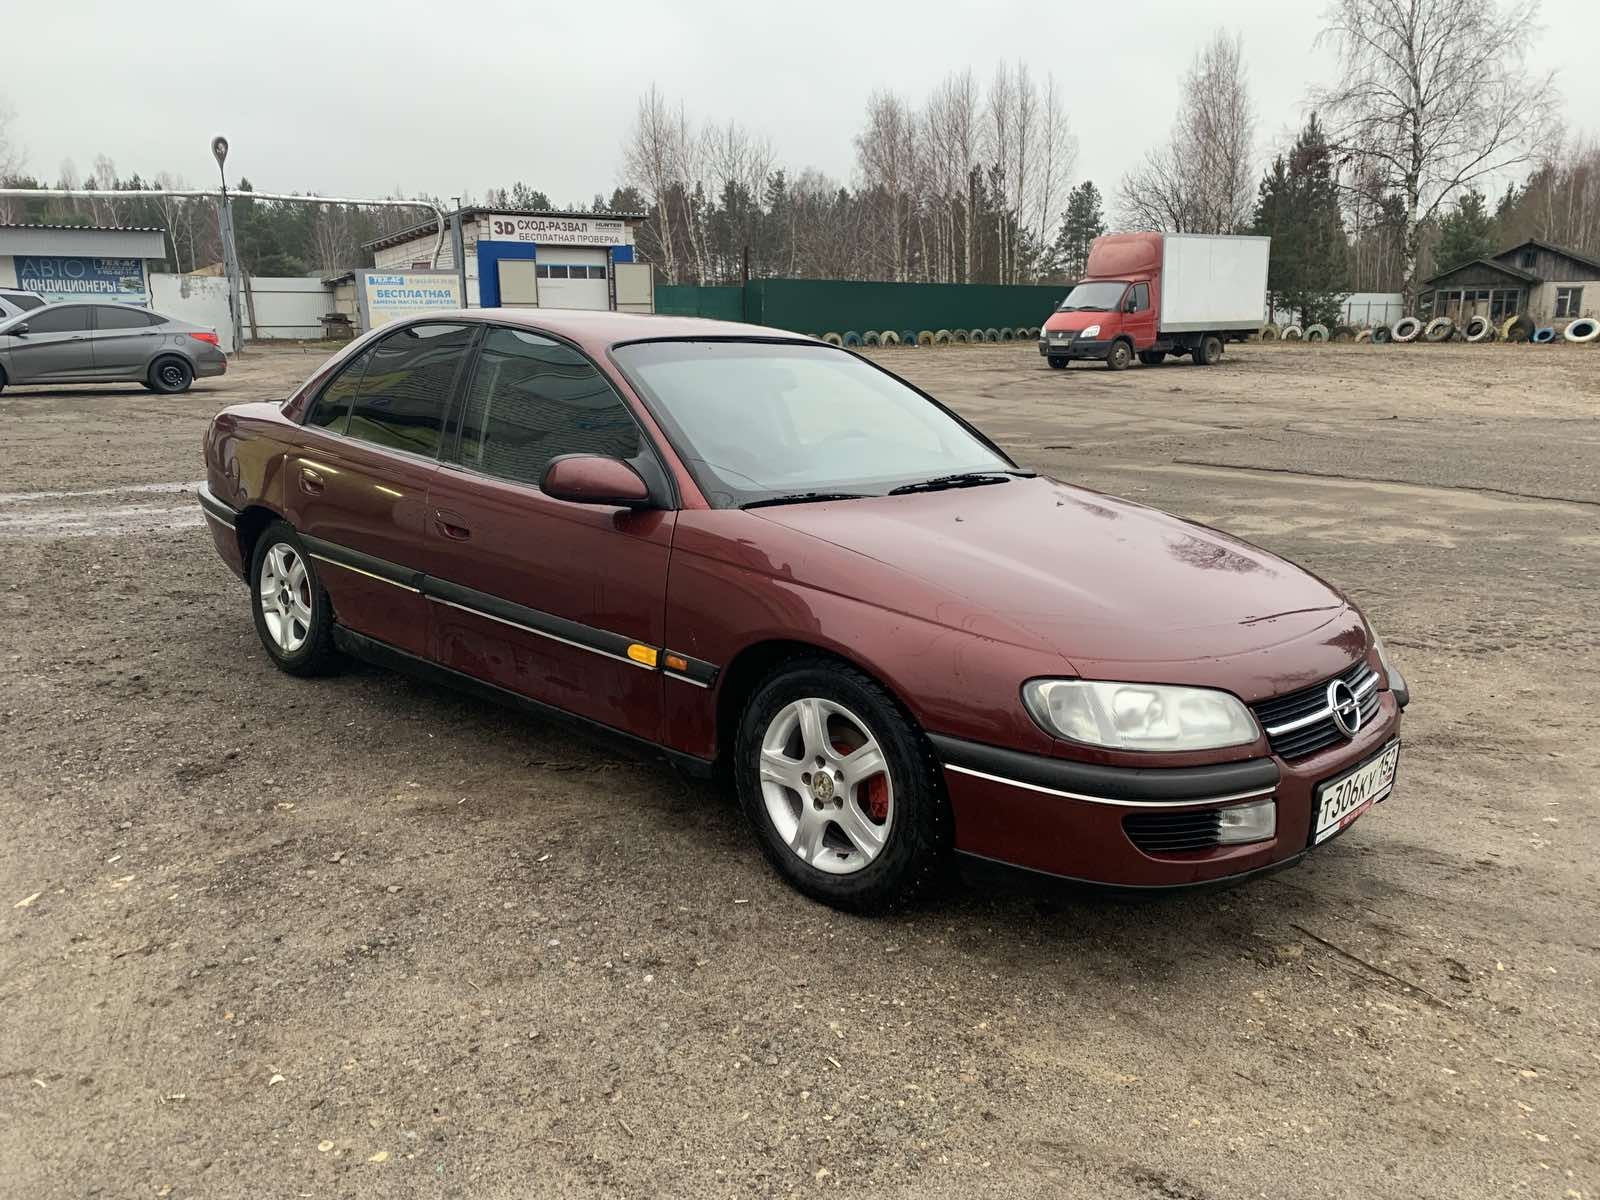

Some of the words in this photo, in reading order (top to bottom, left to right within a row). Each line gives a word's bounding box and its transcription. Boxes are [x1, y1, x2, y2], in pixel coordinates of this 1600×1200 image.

[493, 220, 515, 235] 3D
[517, 219, 588, 233] СХОД-РАЗВАЛ
[519, 232, 576, 242] БЕСПЛАТНАЯ
[577, 234, 620, 244] ПРОВЕРКА
[21, 258, 85, 278] АВТО
[22, 278, 117, 293] КОНДИЦИОНЕРЫ
[376, 289, 451, 298] БЕСПЛАТНАЯ
[1379, 747, 1396, 778] 152
